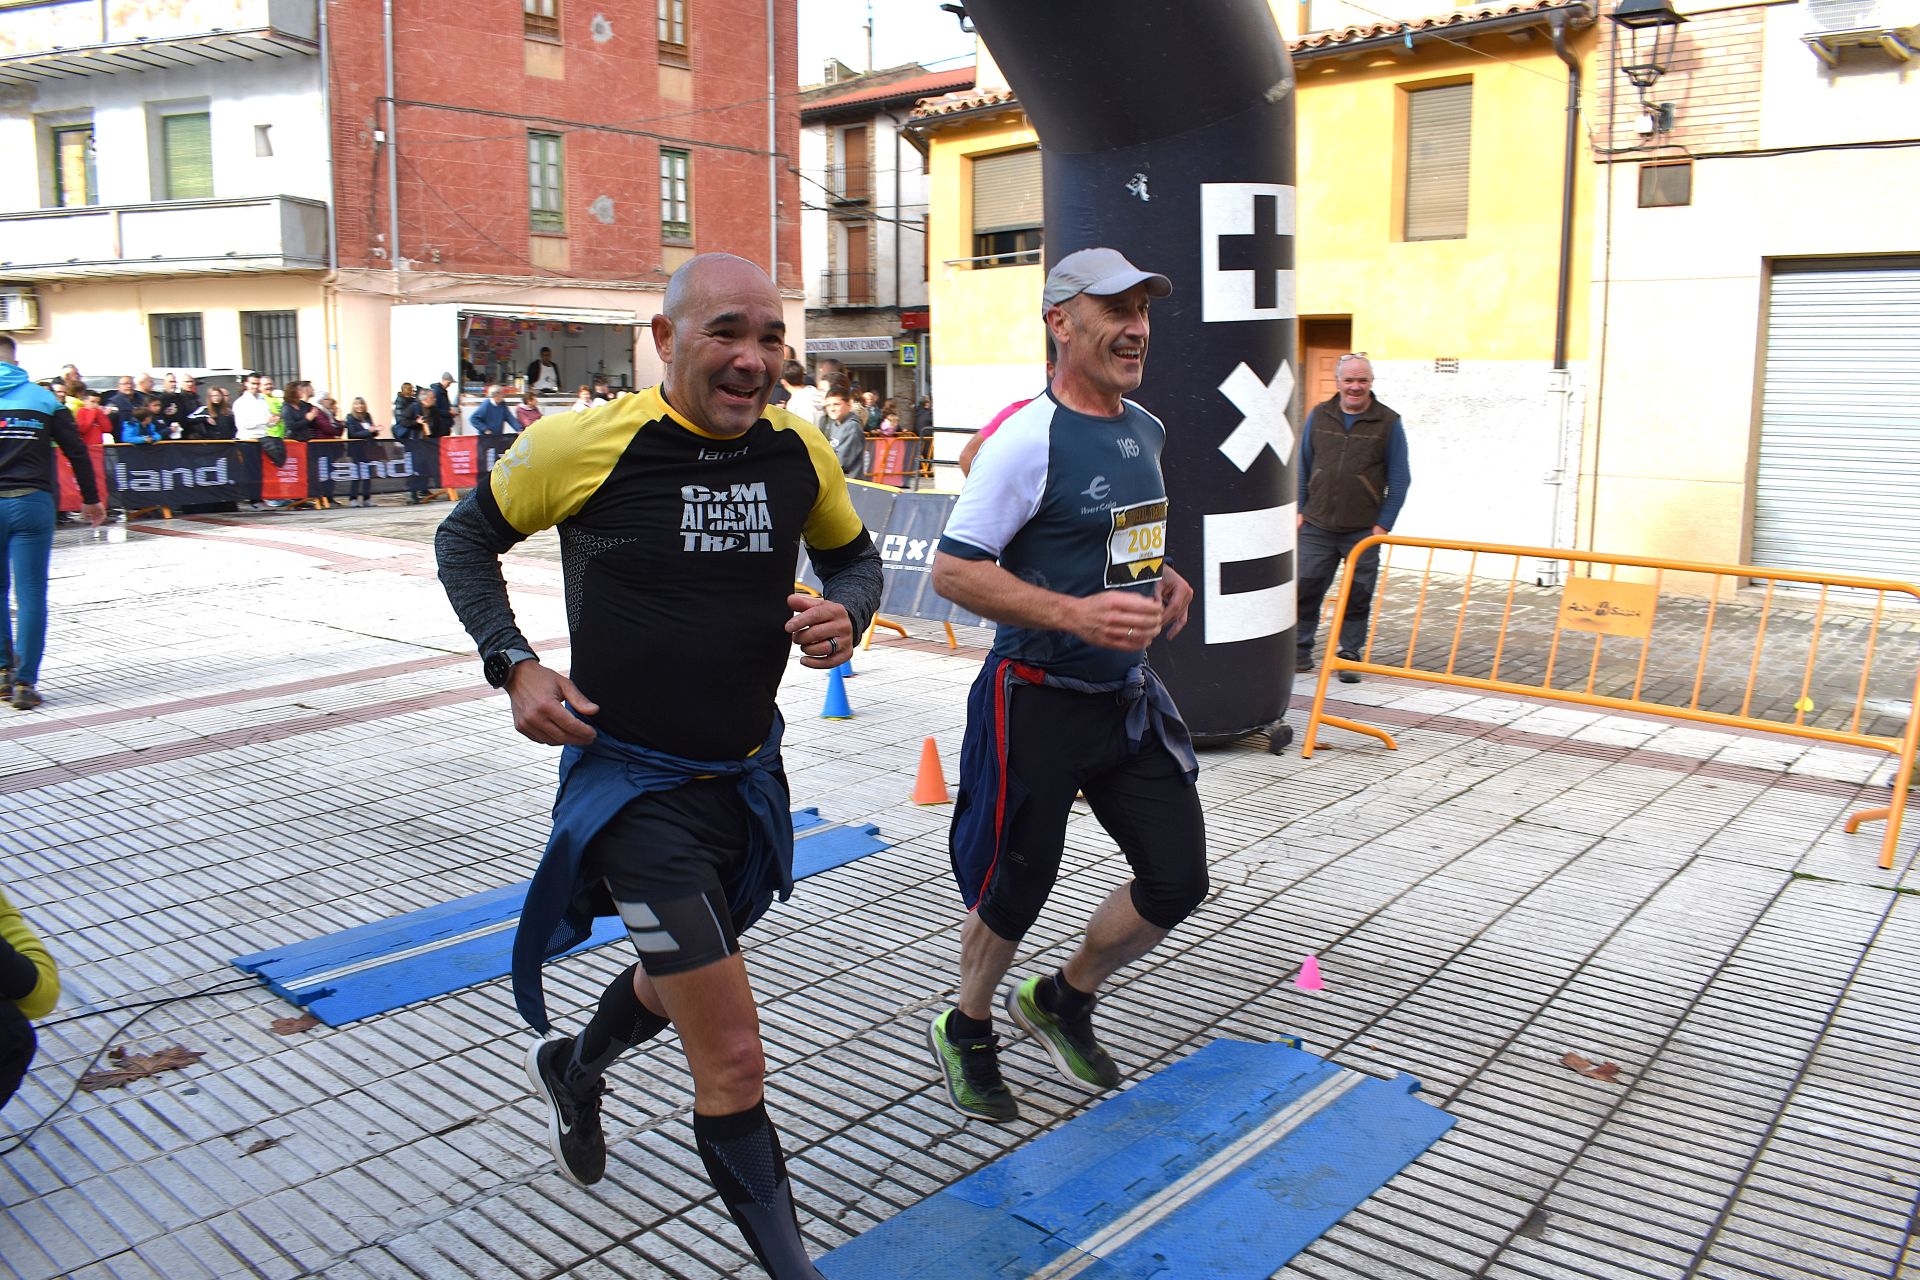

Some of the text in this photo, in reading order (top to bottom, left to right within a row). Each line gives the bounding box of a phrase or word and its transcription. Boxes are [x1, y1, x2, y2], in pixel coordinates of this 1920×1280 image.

[840, 340, 859, 350] MARY
[861, 338, 891, 350] CARMEN
[1127, 525, 1163, 553] 208
